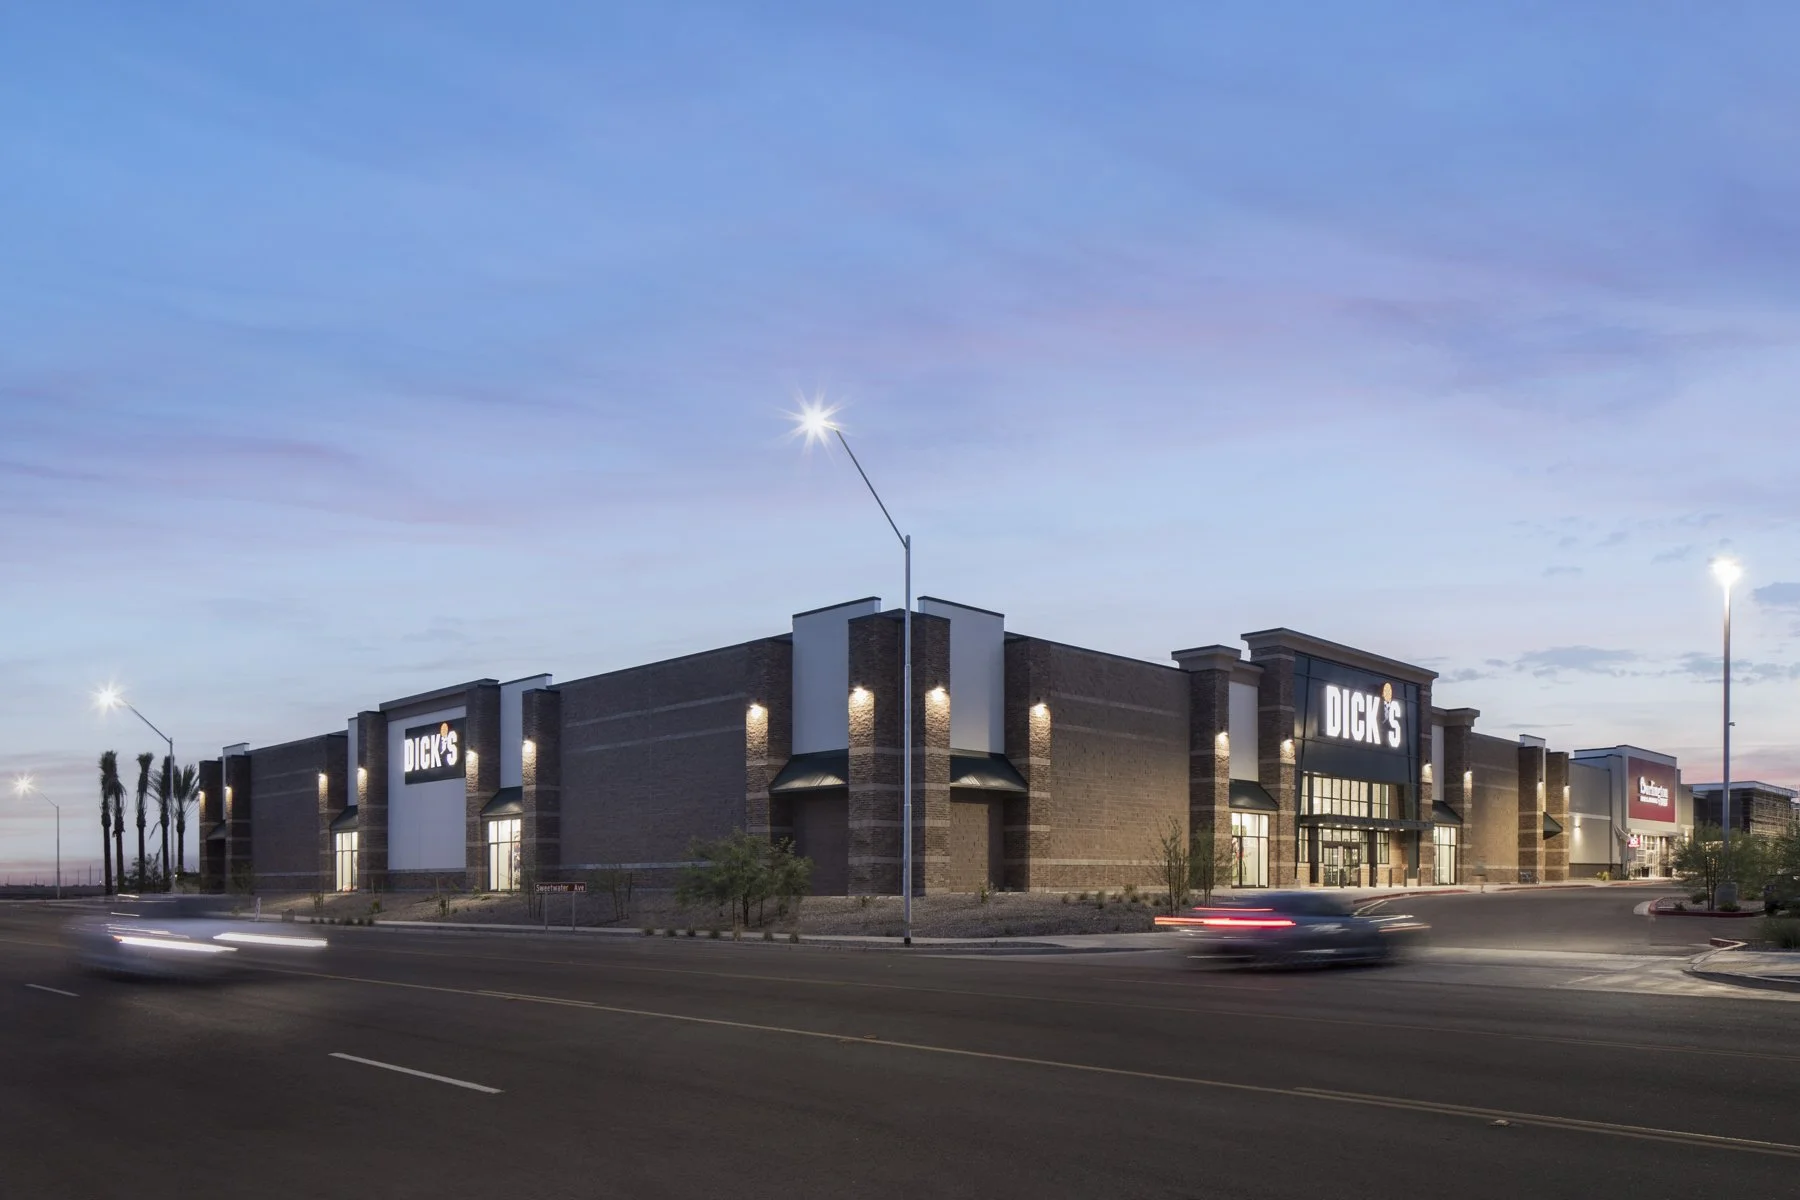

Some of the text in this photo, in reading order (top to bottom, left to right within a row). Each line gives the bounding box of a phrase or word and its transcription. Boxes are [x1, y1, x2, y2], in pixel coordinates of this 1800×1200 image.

[1326, 684, 1401, 748] DICK'S
[404, 729, 458, 772] DICK'S
[535, 884, 585, 892] Sweetwater Ave
